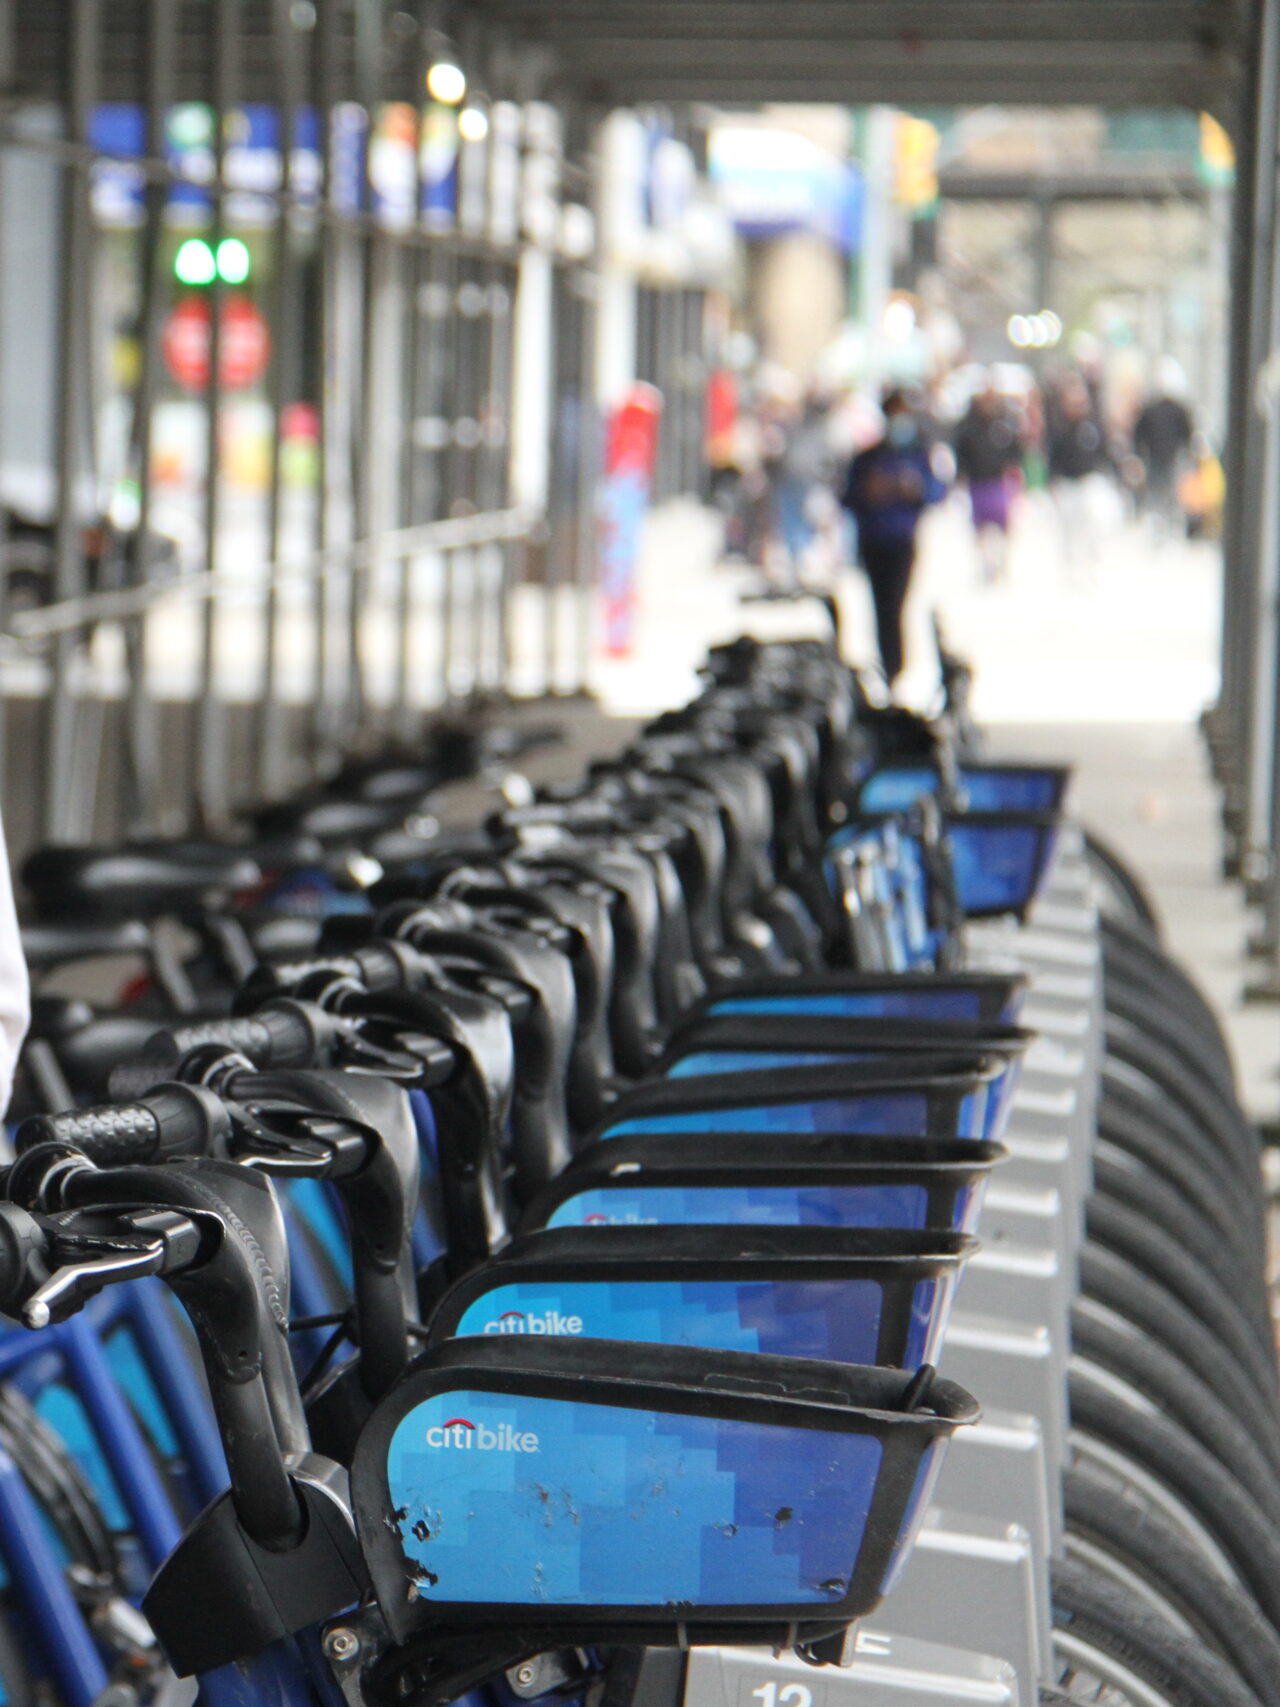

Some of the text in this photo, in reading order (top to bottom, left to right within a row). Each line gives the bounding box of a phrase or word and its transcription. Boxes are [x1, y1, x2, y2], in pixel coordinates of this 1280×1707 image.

[483, 1310, 583, 1335] citi bike
[426, 1421, 540, 1453] citi bike
